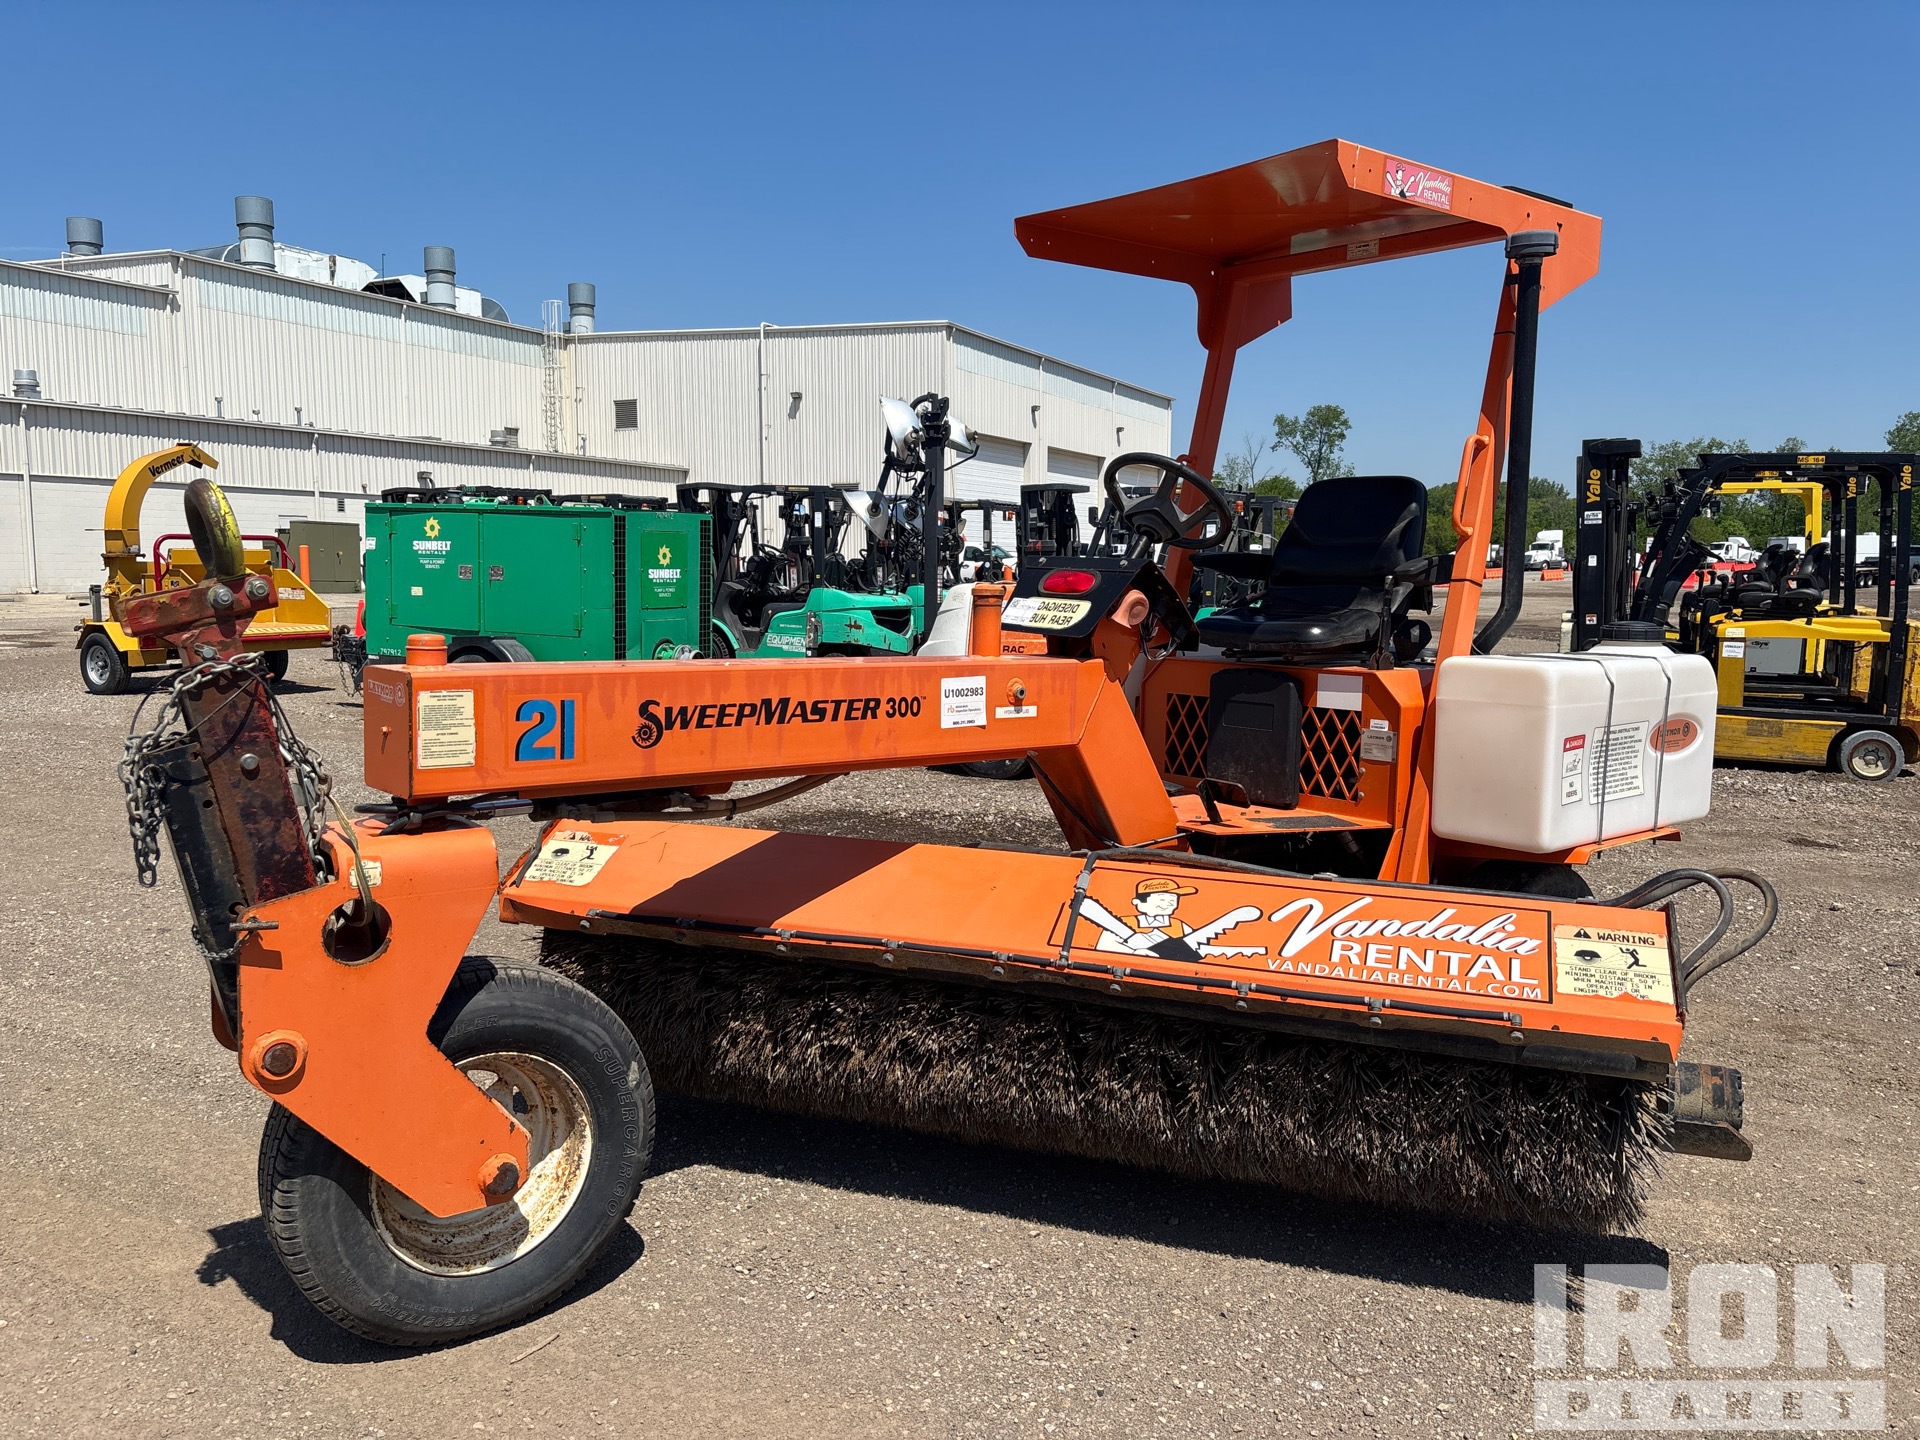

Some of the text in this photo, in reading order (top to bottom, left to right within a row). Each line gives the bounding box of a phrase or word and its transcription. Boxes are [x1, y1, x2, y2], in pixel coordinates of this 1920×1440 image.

[1416, 171, 1452, 195] Vandalia
[1423, 189, 1450, 205] RENTAL
[148, 453, 185, 477] Vermeer
[1586, 468, 1601, 504] Yale
[1900, 465, 1912, 491] Yale
[1847, 476, 1857, 498] Yale
[412, 540, 452, 550] SUNBELT
[648, 568, 681, 578] SUNBELT
[380, 648, 402, 656] 797912
[368, 680, 394, 699] LAYMOR
[944, 686, 984, 698] U1002983
[514, 699, 576, 762] 21
[1660, 728, 1681, 738] LYMOR
[1570, 738, 1584, 746] DANGER
[1566, 790, 1578, 798] RIDERS
[1268, 896, 1543, 958] Vandalia
[1596, 932, 1656, 946] WARNING
[1329, 939, 1540, 985] RENTAL
[1266, 958, 1543, 1000] VANDALIARENTAL.COM
[1565, 970, 1596, 978] MINIMUM
[1600, 974, 1634, 982] DISTANCE
[1594, 978, 1625, 987] MACHINE
[594, 1048, 639, 1218] SUPERCARGO
